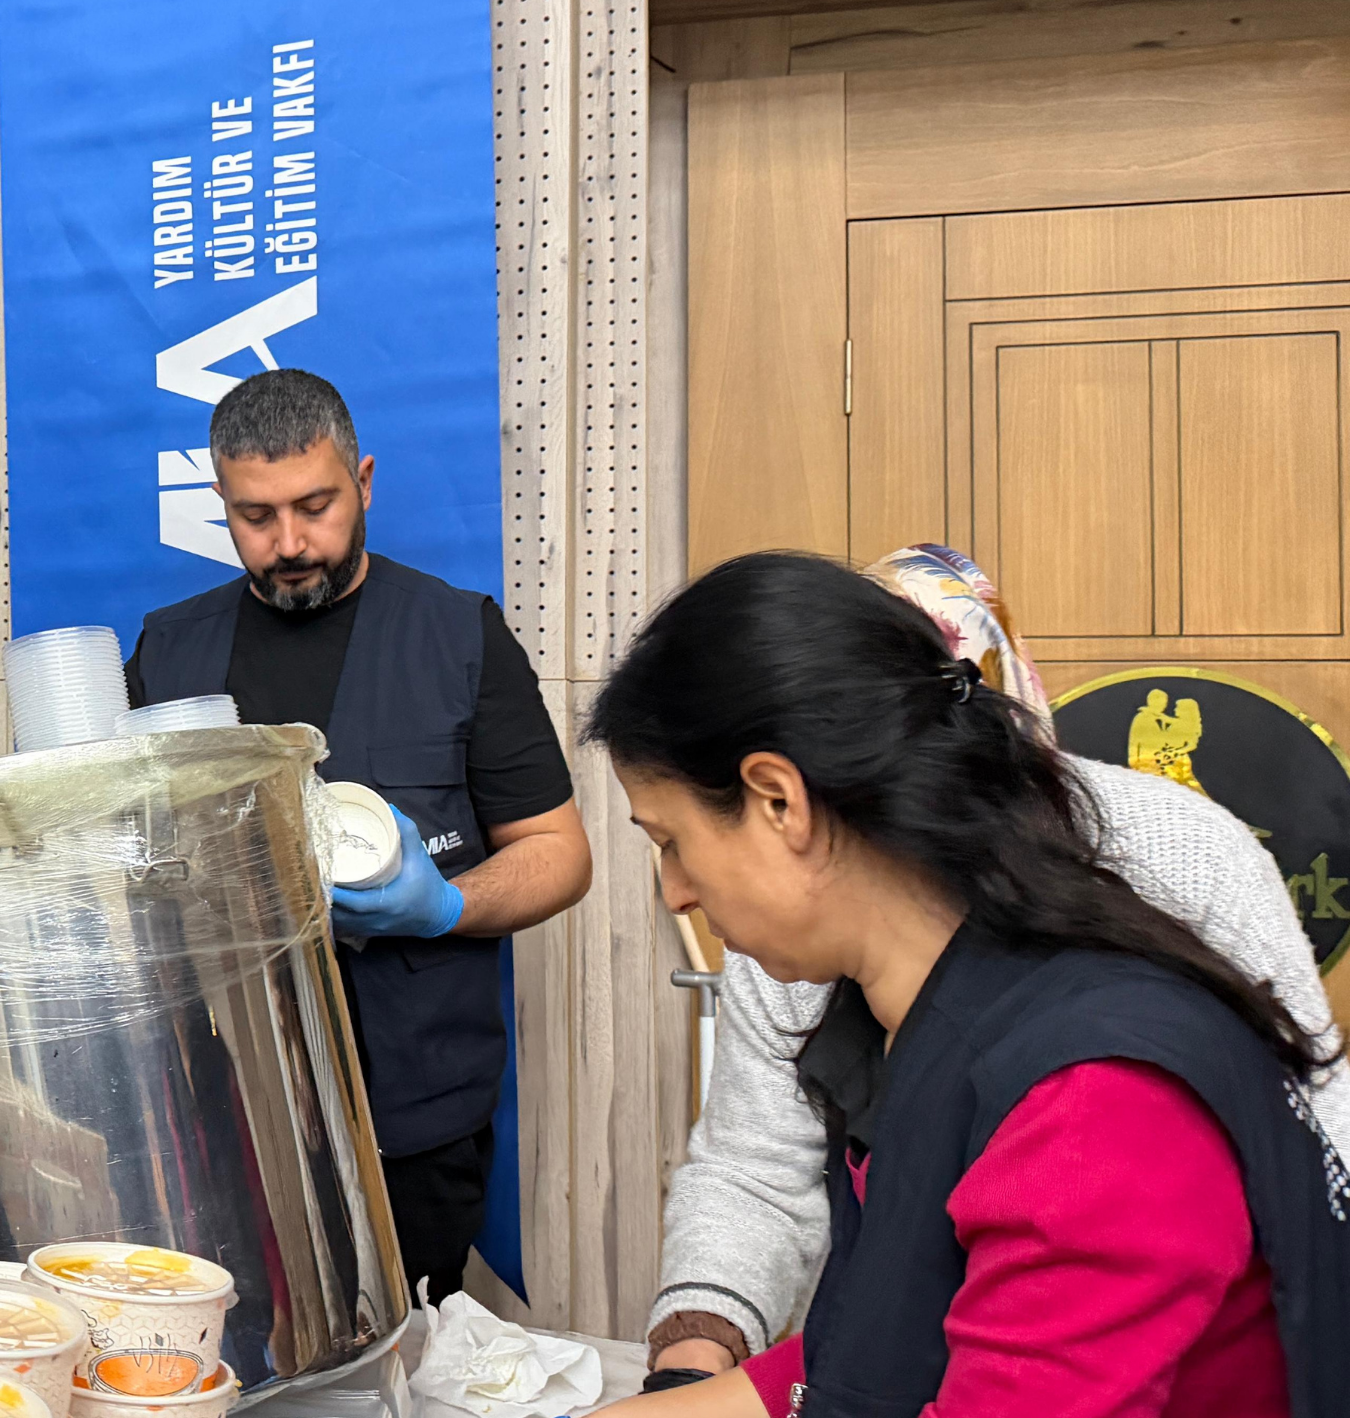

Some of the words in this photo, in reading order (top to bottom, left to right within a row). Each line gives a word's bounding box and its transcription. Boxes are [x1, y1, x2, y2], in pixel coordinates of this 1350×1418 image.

[211, 96, 252, 142] VE
[272, 39, 315, 142] VAKFI
[152, 155, 194, 289] YARDIM
[203, 150, 255, 282] KÜLTÜR
[264, 151, 317, 275] EĞİTİM
